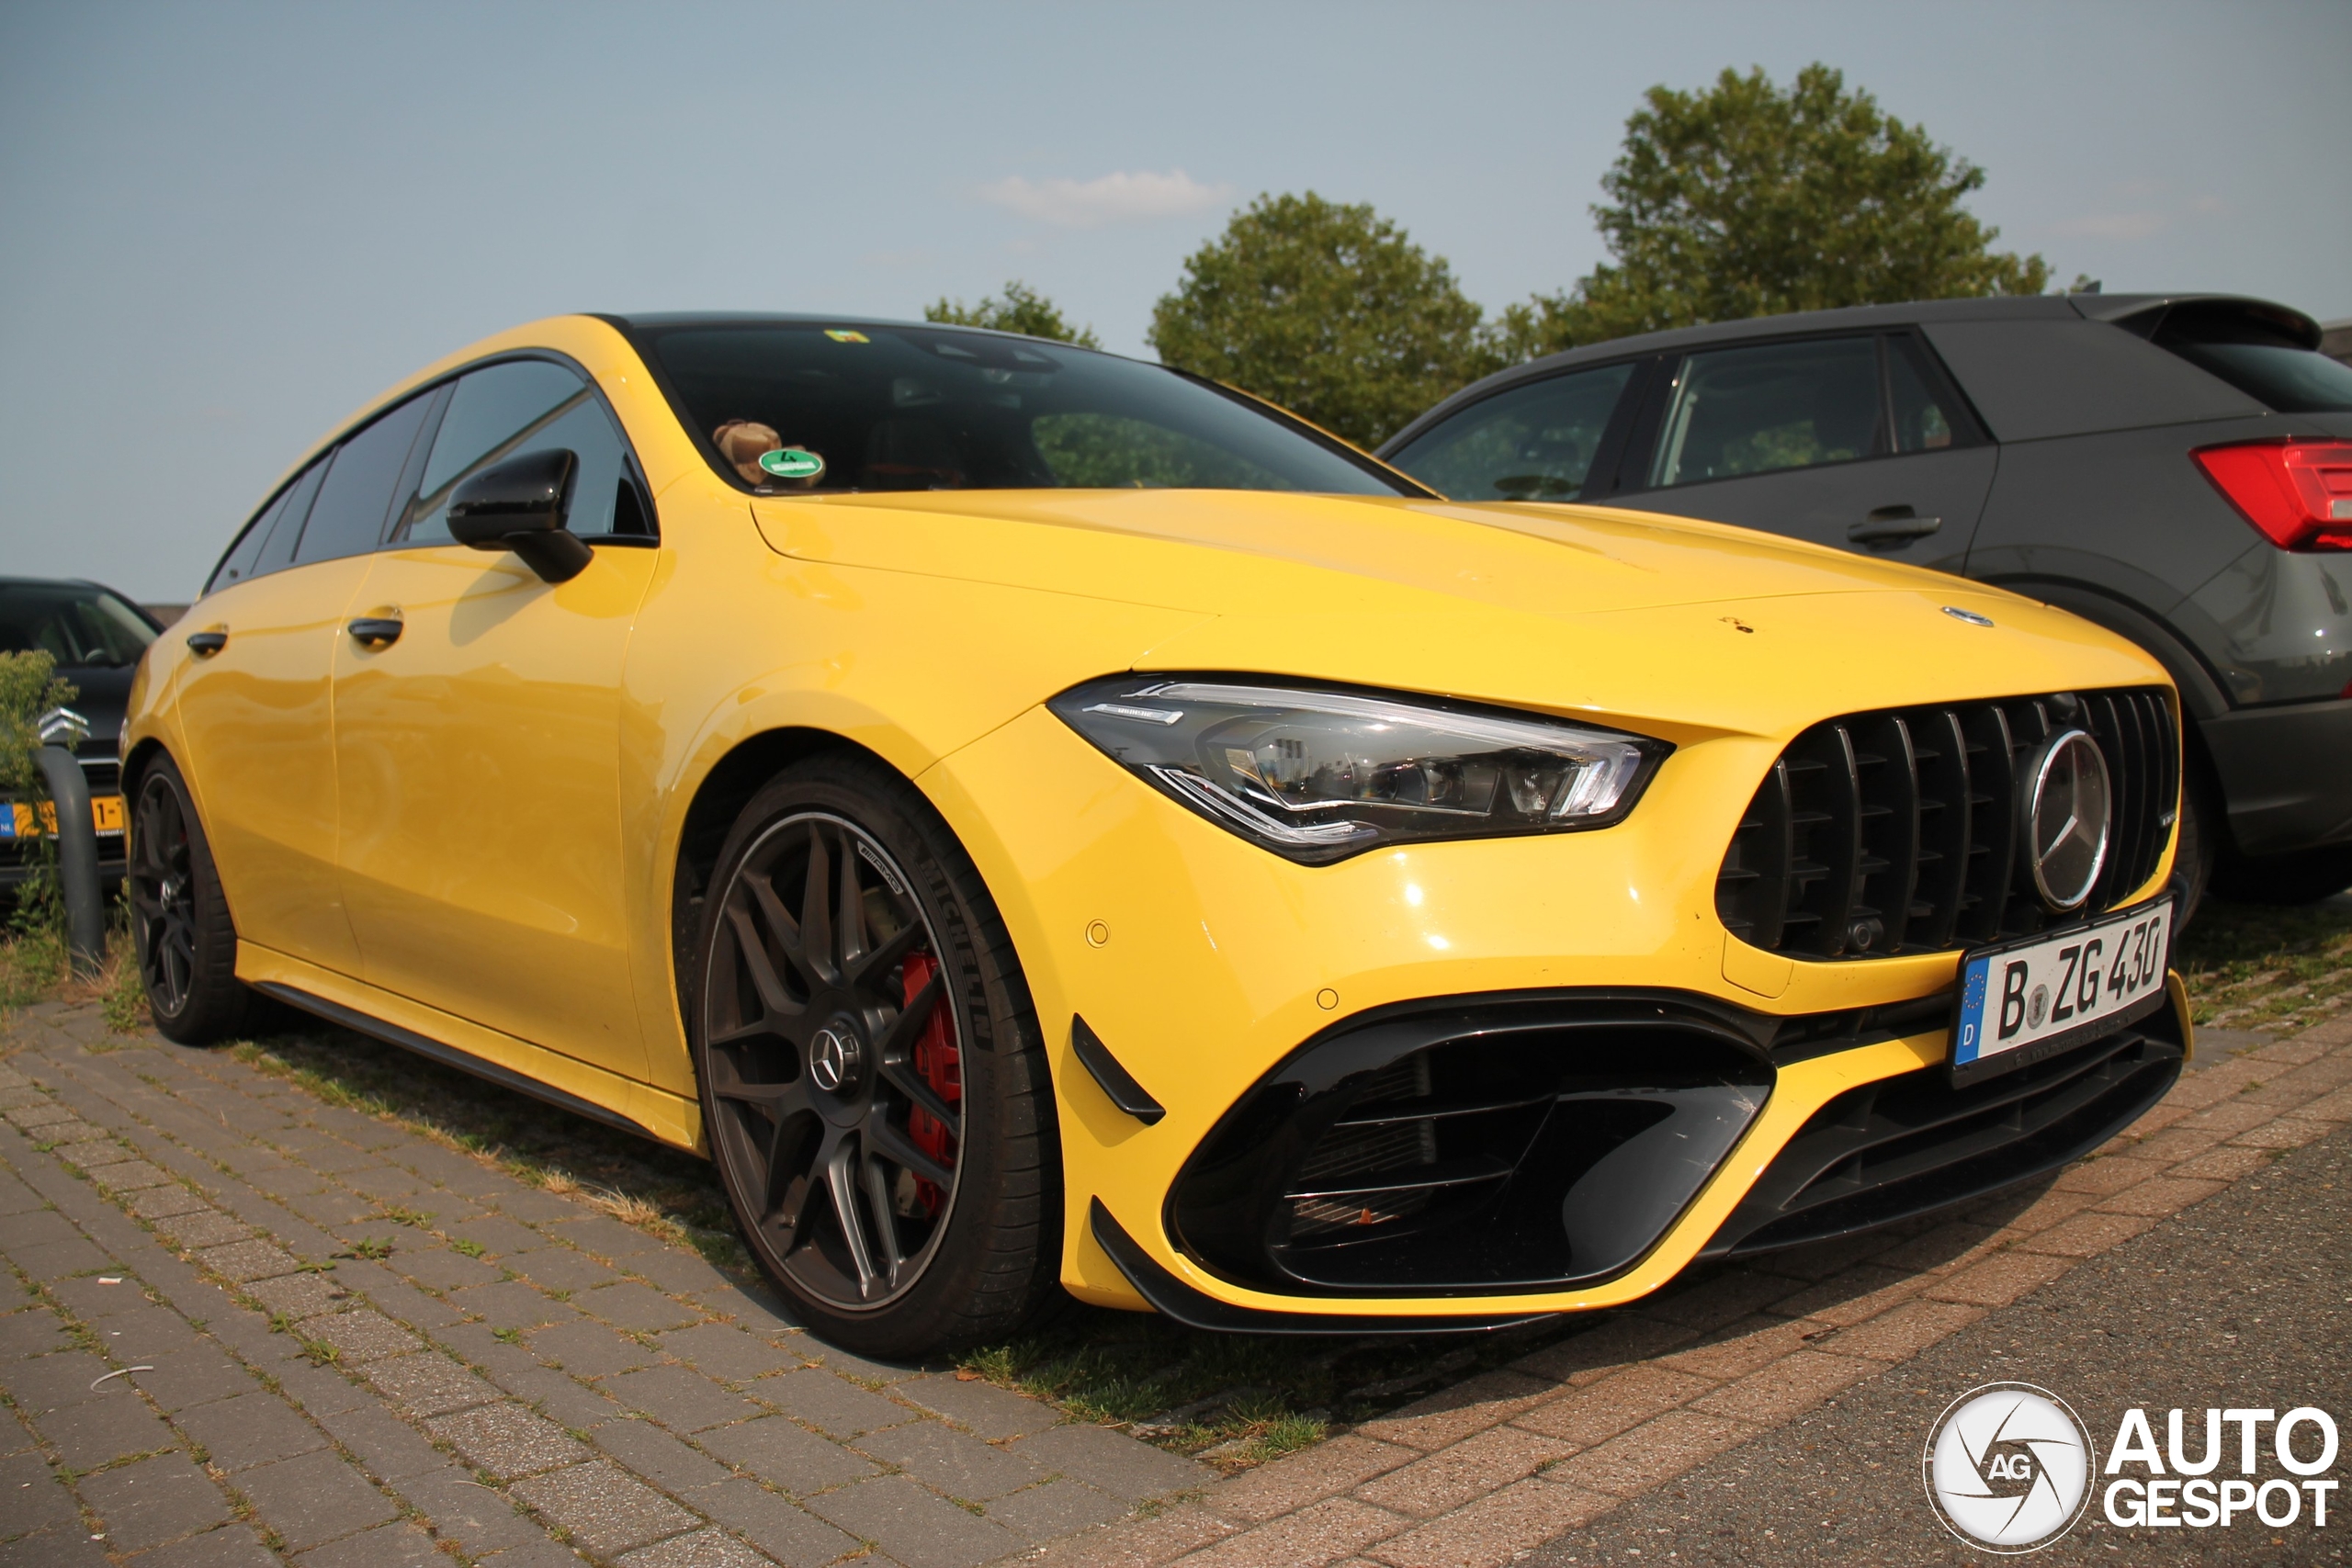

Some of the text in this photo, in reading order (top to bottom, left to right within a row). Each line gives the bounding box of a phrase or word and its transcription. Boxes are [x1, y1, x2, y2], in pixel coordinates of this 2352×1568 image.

[920, 858, 992, 1038] MICHELIN
[1997, 960, 2029, 1041] B
[2051, 938, 2103, 1023] ZG
[2107, 916, 2161, 1000] 430
[1962, 1023, 1974, 1046] D
